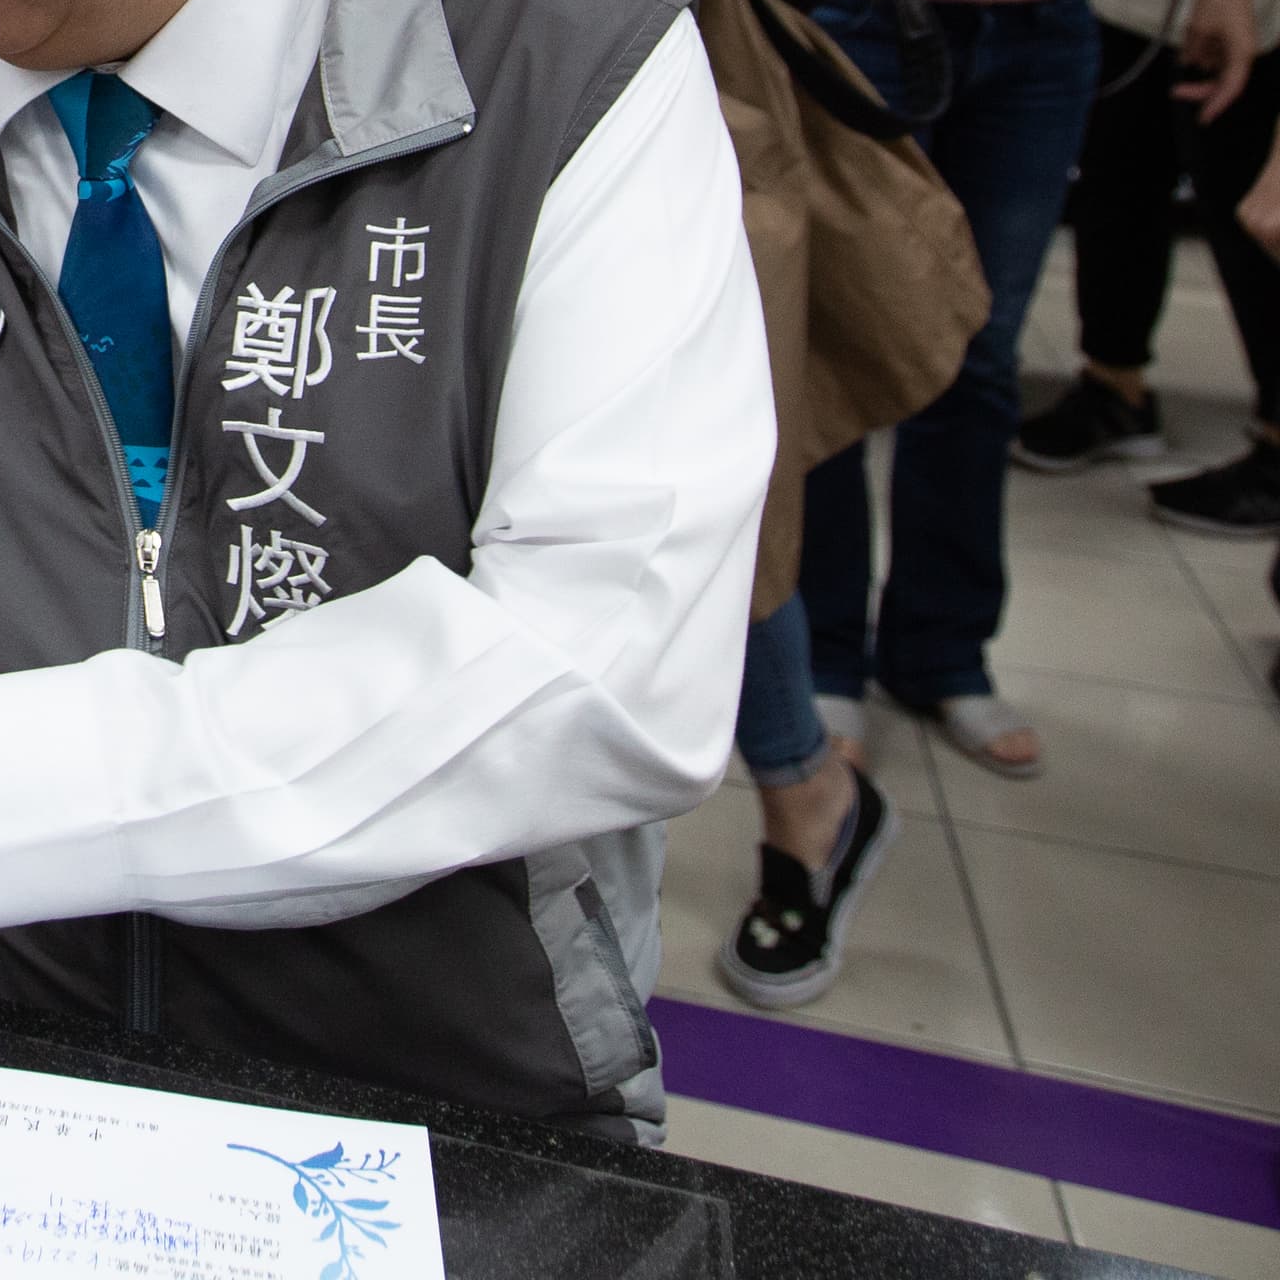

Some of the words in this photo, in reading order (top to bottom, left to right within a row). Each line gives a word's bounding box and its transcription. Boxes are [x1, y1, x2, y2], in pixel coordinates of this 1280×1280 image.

[354, 216, 431, 365] 市長
[220, 282, 338, 638] 鄭文燦
